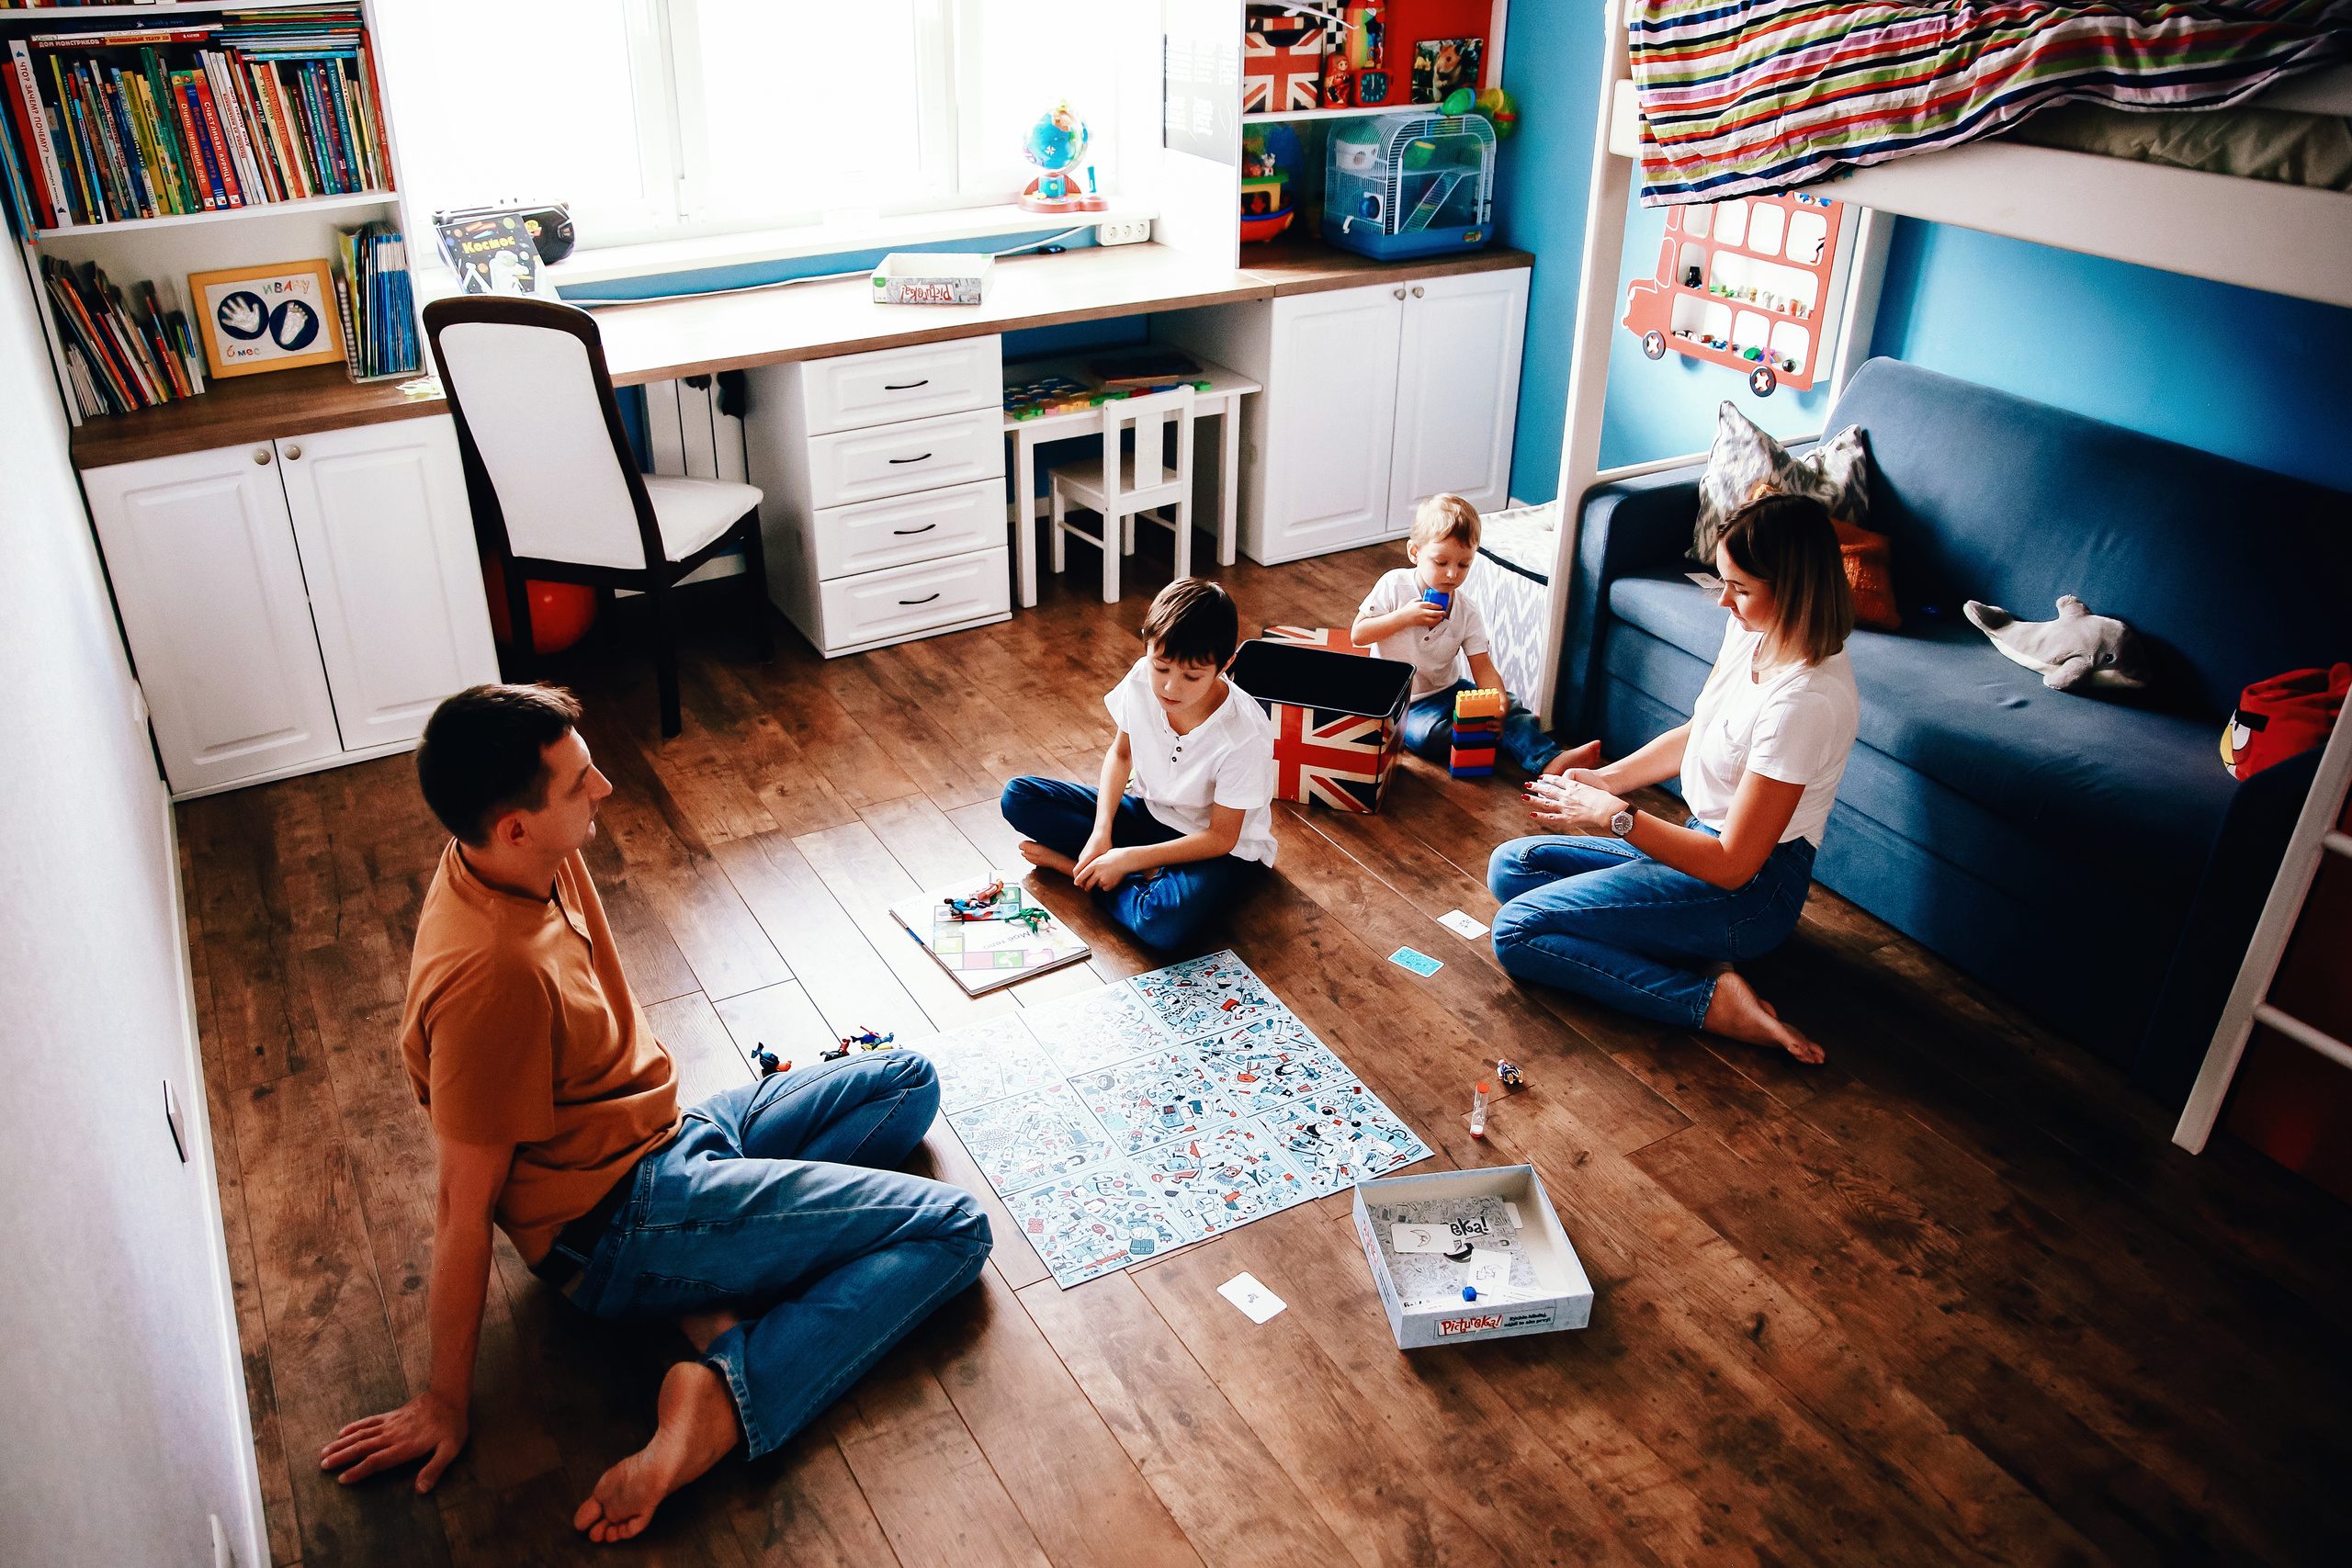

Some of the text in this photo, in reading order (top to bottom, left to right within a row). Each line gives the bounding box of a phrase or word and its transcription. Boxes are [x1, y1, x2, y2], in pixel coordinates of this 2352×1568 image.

[55, 38, 99, 46] МОНСТРИКОВ
[157, 67, 167, 89] ШАПОЧКА
[329, 68, 339, 91] ГОРОДА
[18, 61, 50, 153] ЧТО? ЗАЧЕМ? ПОЧЕМУ?
[254, 99, 266, 124] ДЕТЯМ
[334, 92, 348, 132] ИЗУМРУДНОГО
[179, 102, 192, 128] Очень
[187, 130, 202, 166] ленивый
[198, 168, 207, 184] лев
[191, 106, 208, 142] Весёлые
[201, 145, 217, 179] тигрята
[202, 100, 232, 182] Счастливая курица
[343, 132, 356, 169] ВОЛШЕБНИК
[461, 235, 516, 254] Космос
[263, 280, 311, 295] ИВАНУ
[900, 284, 953, 301] Pictureka!
[226, 345, 260, 357] 6 мес
[983, 939, 1007, 950] тело
[1446, 1216, 1488, 1236] eka!
[1441, 1314, 1503, 1336] Pictureka!
